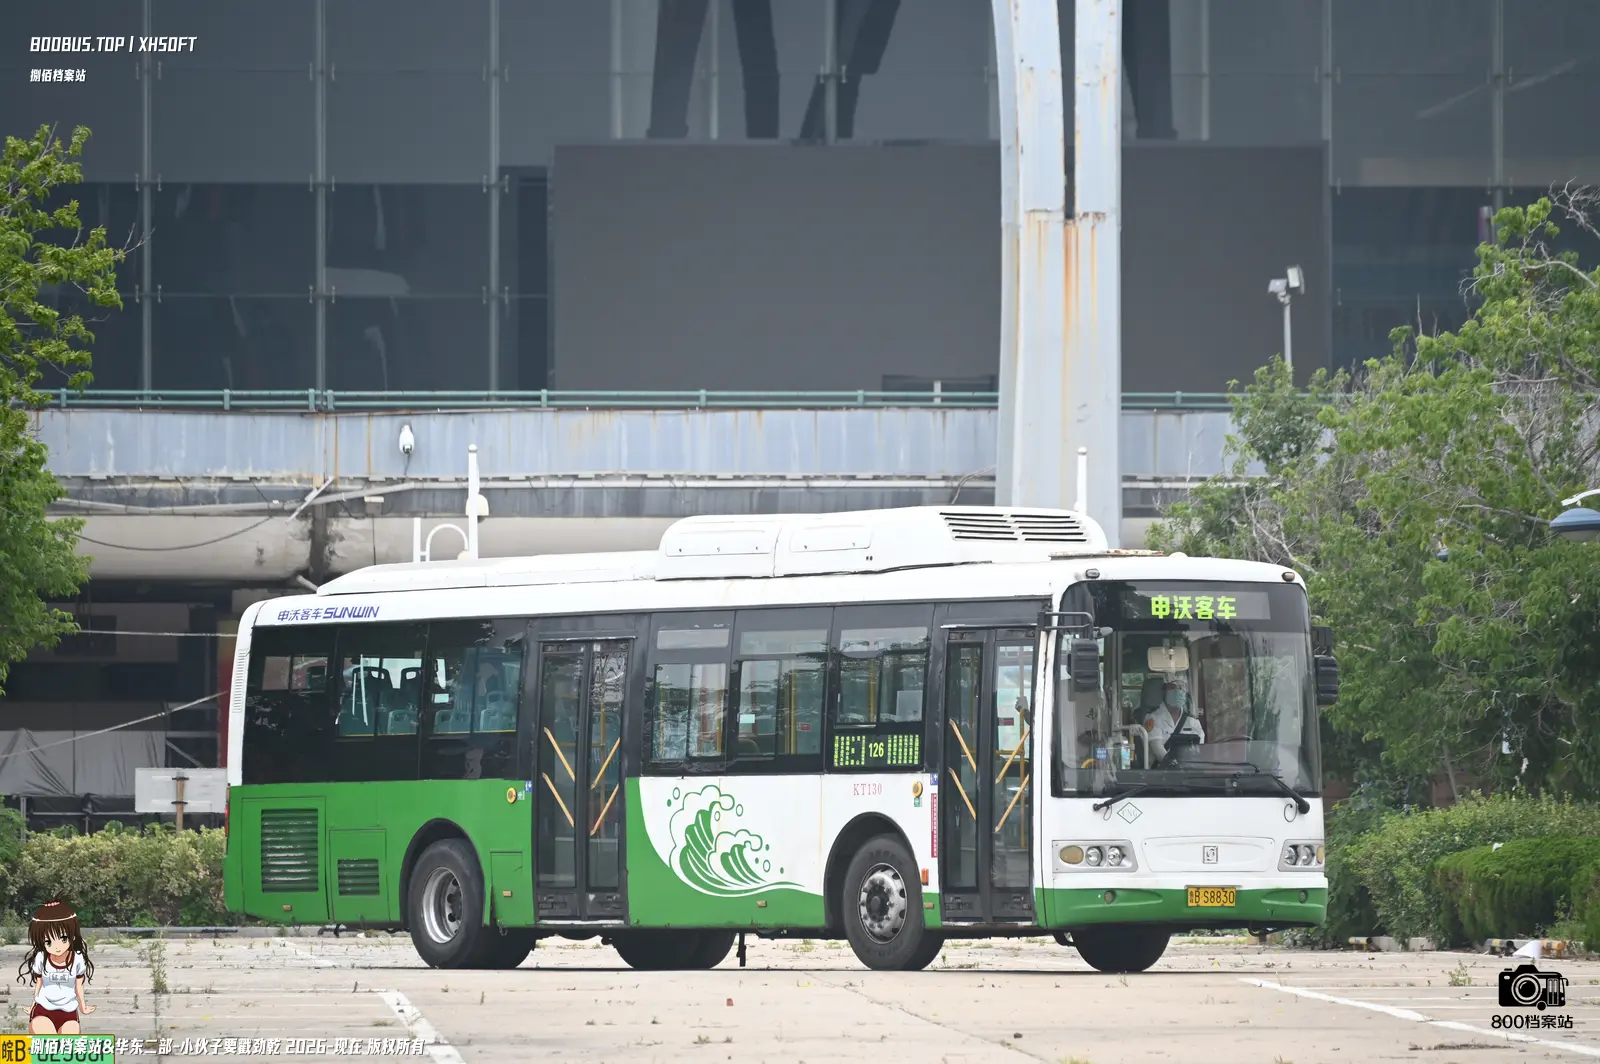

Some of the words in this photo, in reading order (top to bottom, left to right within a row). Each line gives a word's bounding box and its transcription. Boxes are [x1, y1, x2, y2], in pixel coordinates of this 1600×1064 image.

[278, 608, 323, 622] 申沃客车
[323, 606, 380, 619] SUNWIN
[1151, 594, 1237, 620] 申沃客车
[868, 742, 885, 758] 126
[853, 783, 883, 796] KT130
